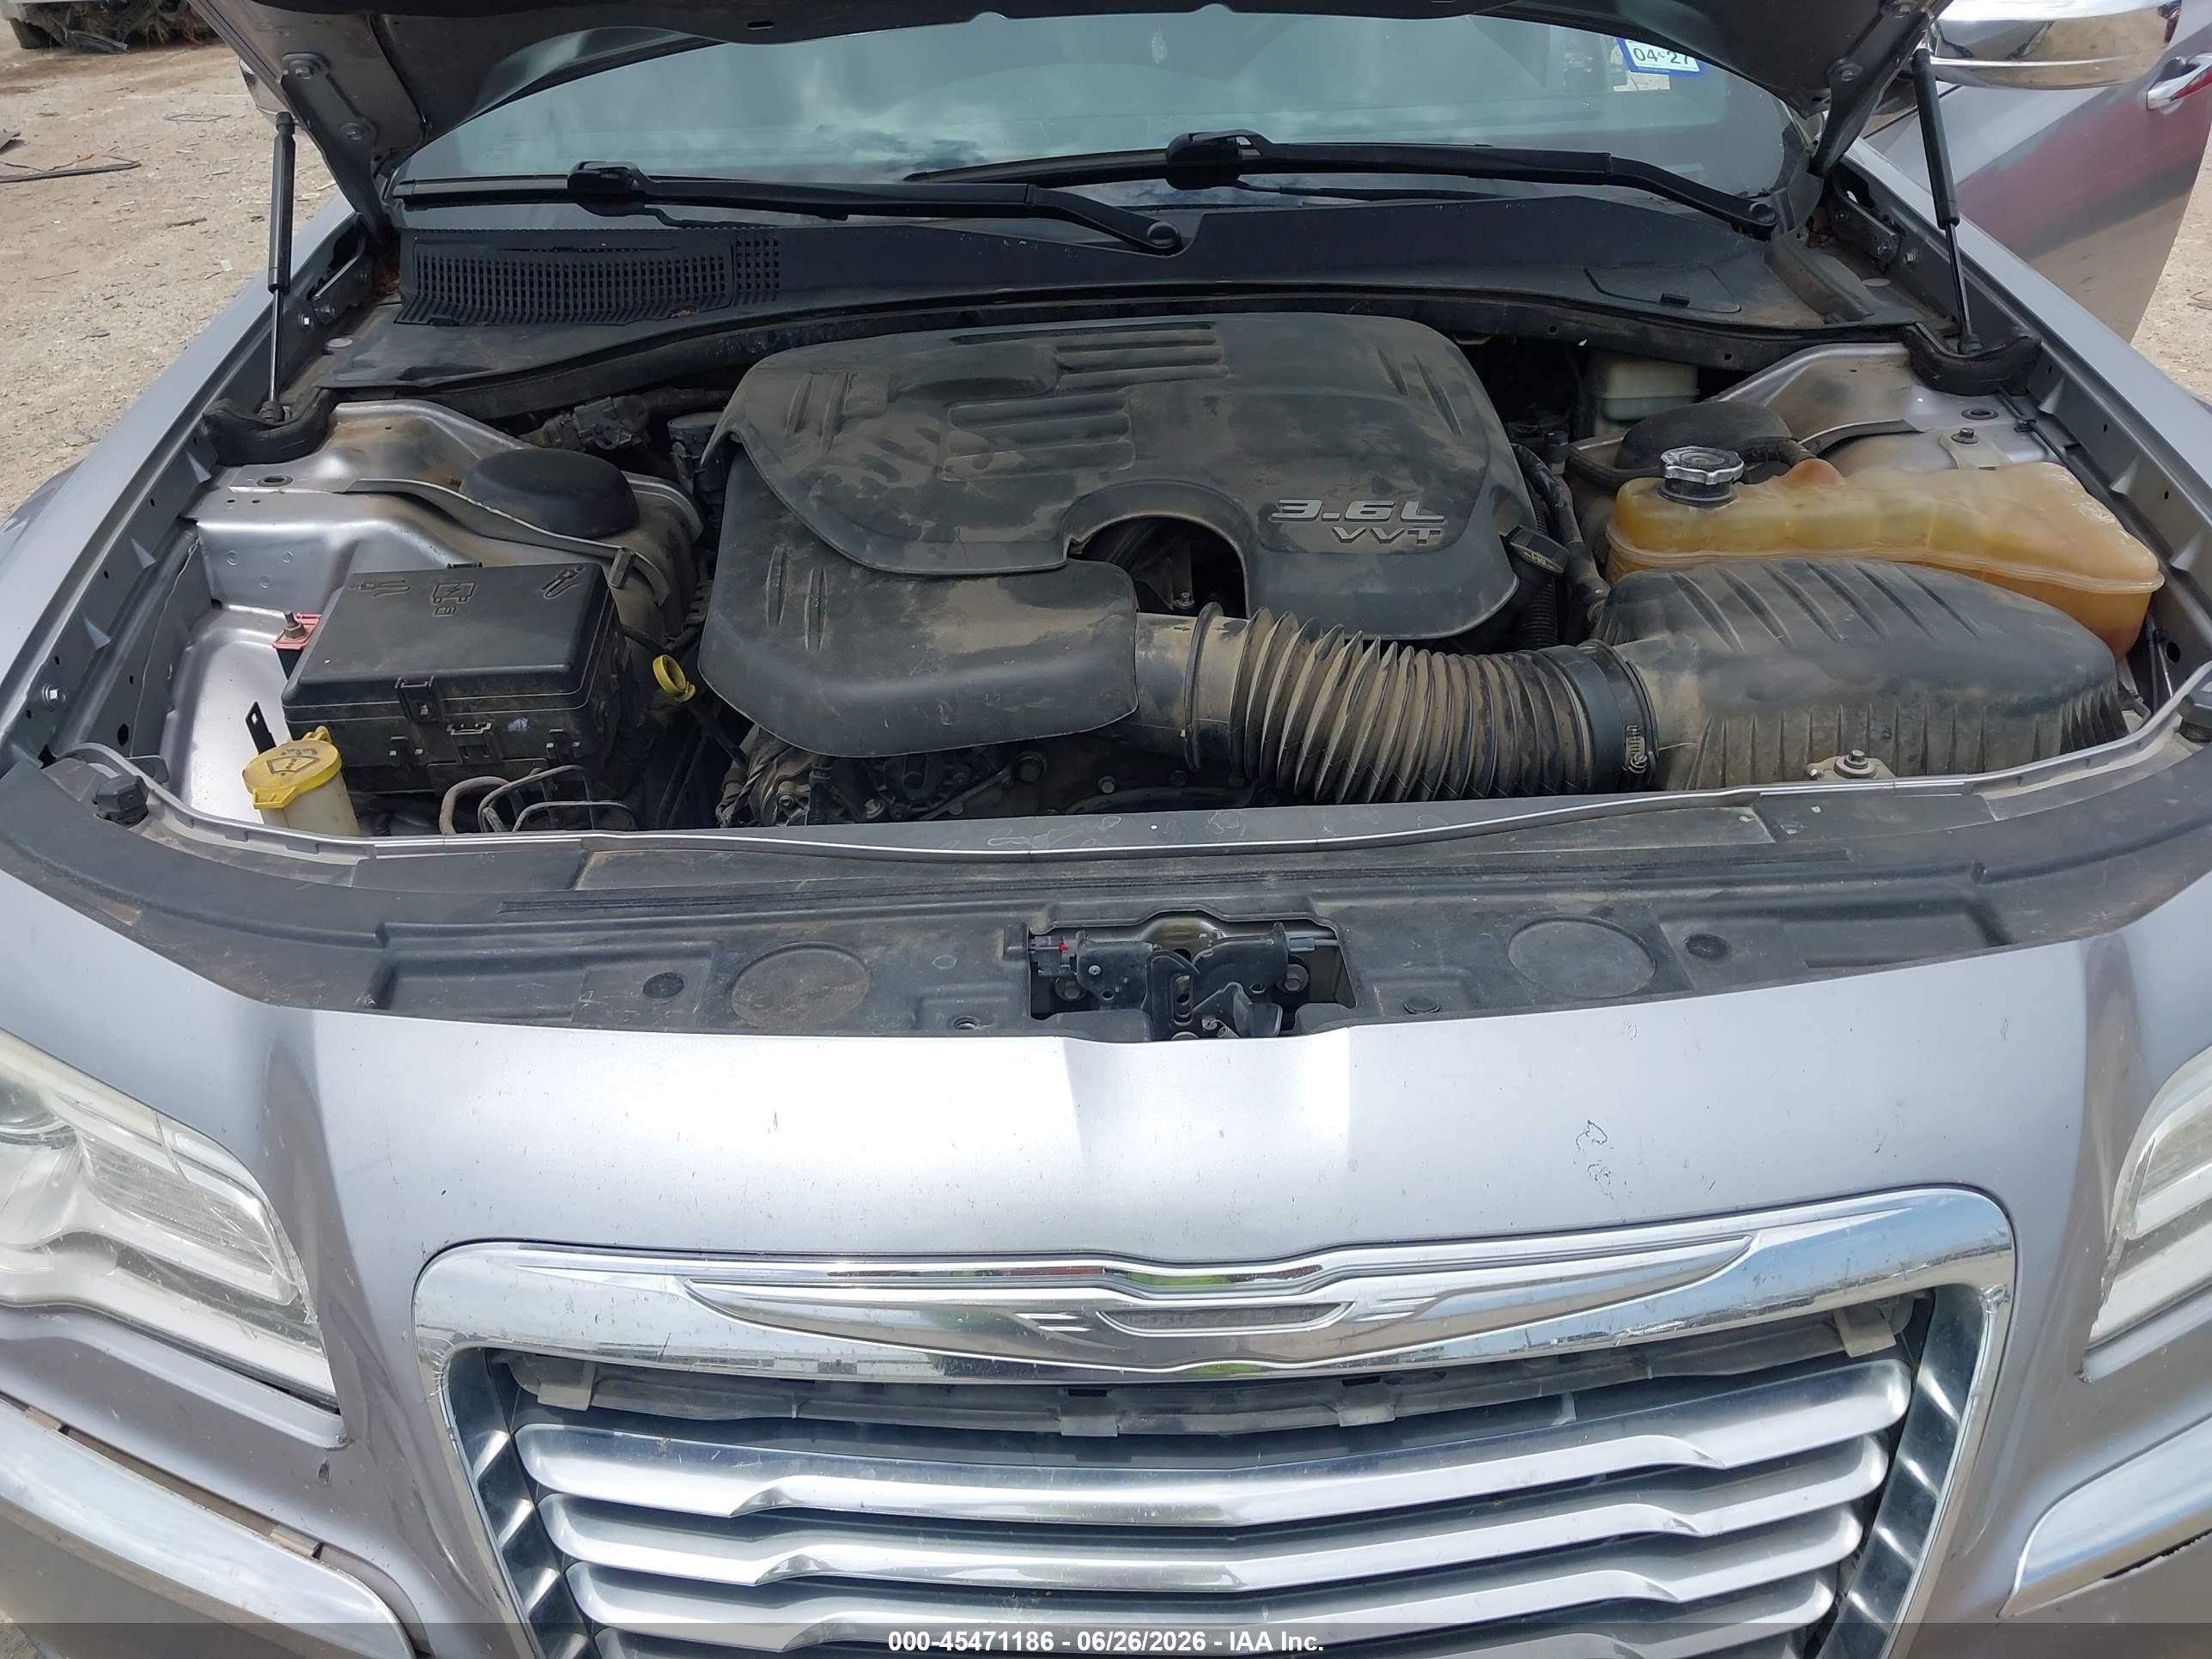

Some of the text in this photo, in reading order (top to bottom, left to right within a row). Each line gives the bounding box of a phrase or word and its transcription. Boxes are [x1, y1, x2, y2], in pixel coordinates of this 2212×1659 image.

[1632, 47, 1658, 62] 04
[1269, 499, 1445, 523] 3.6L
[1332, 526, 1442, 545] VVT
